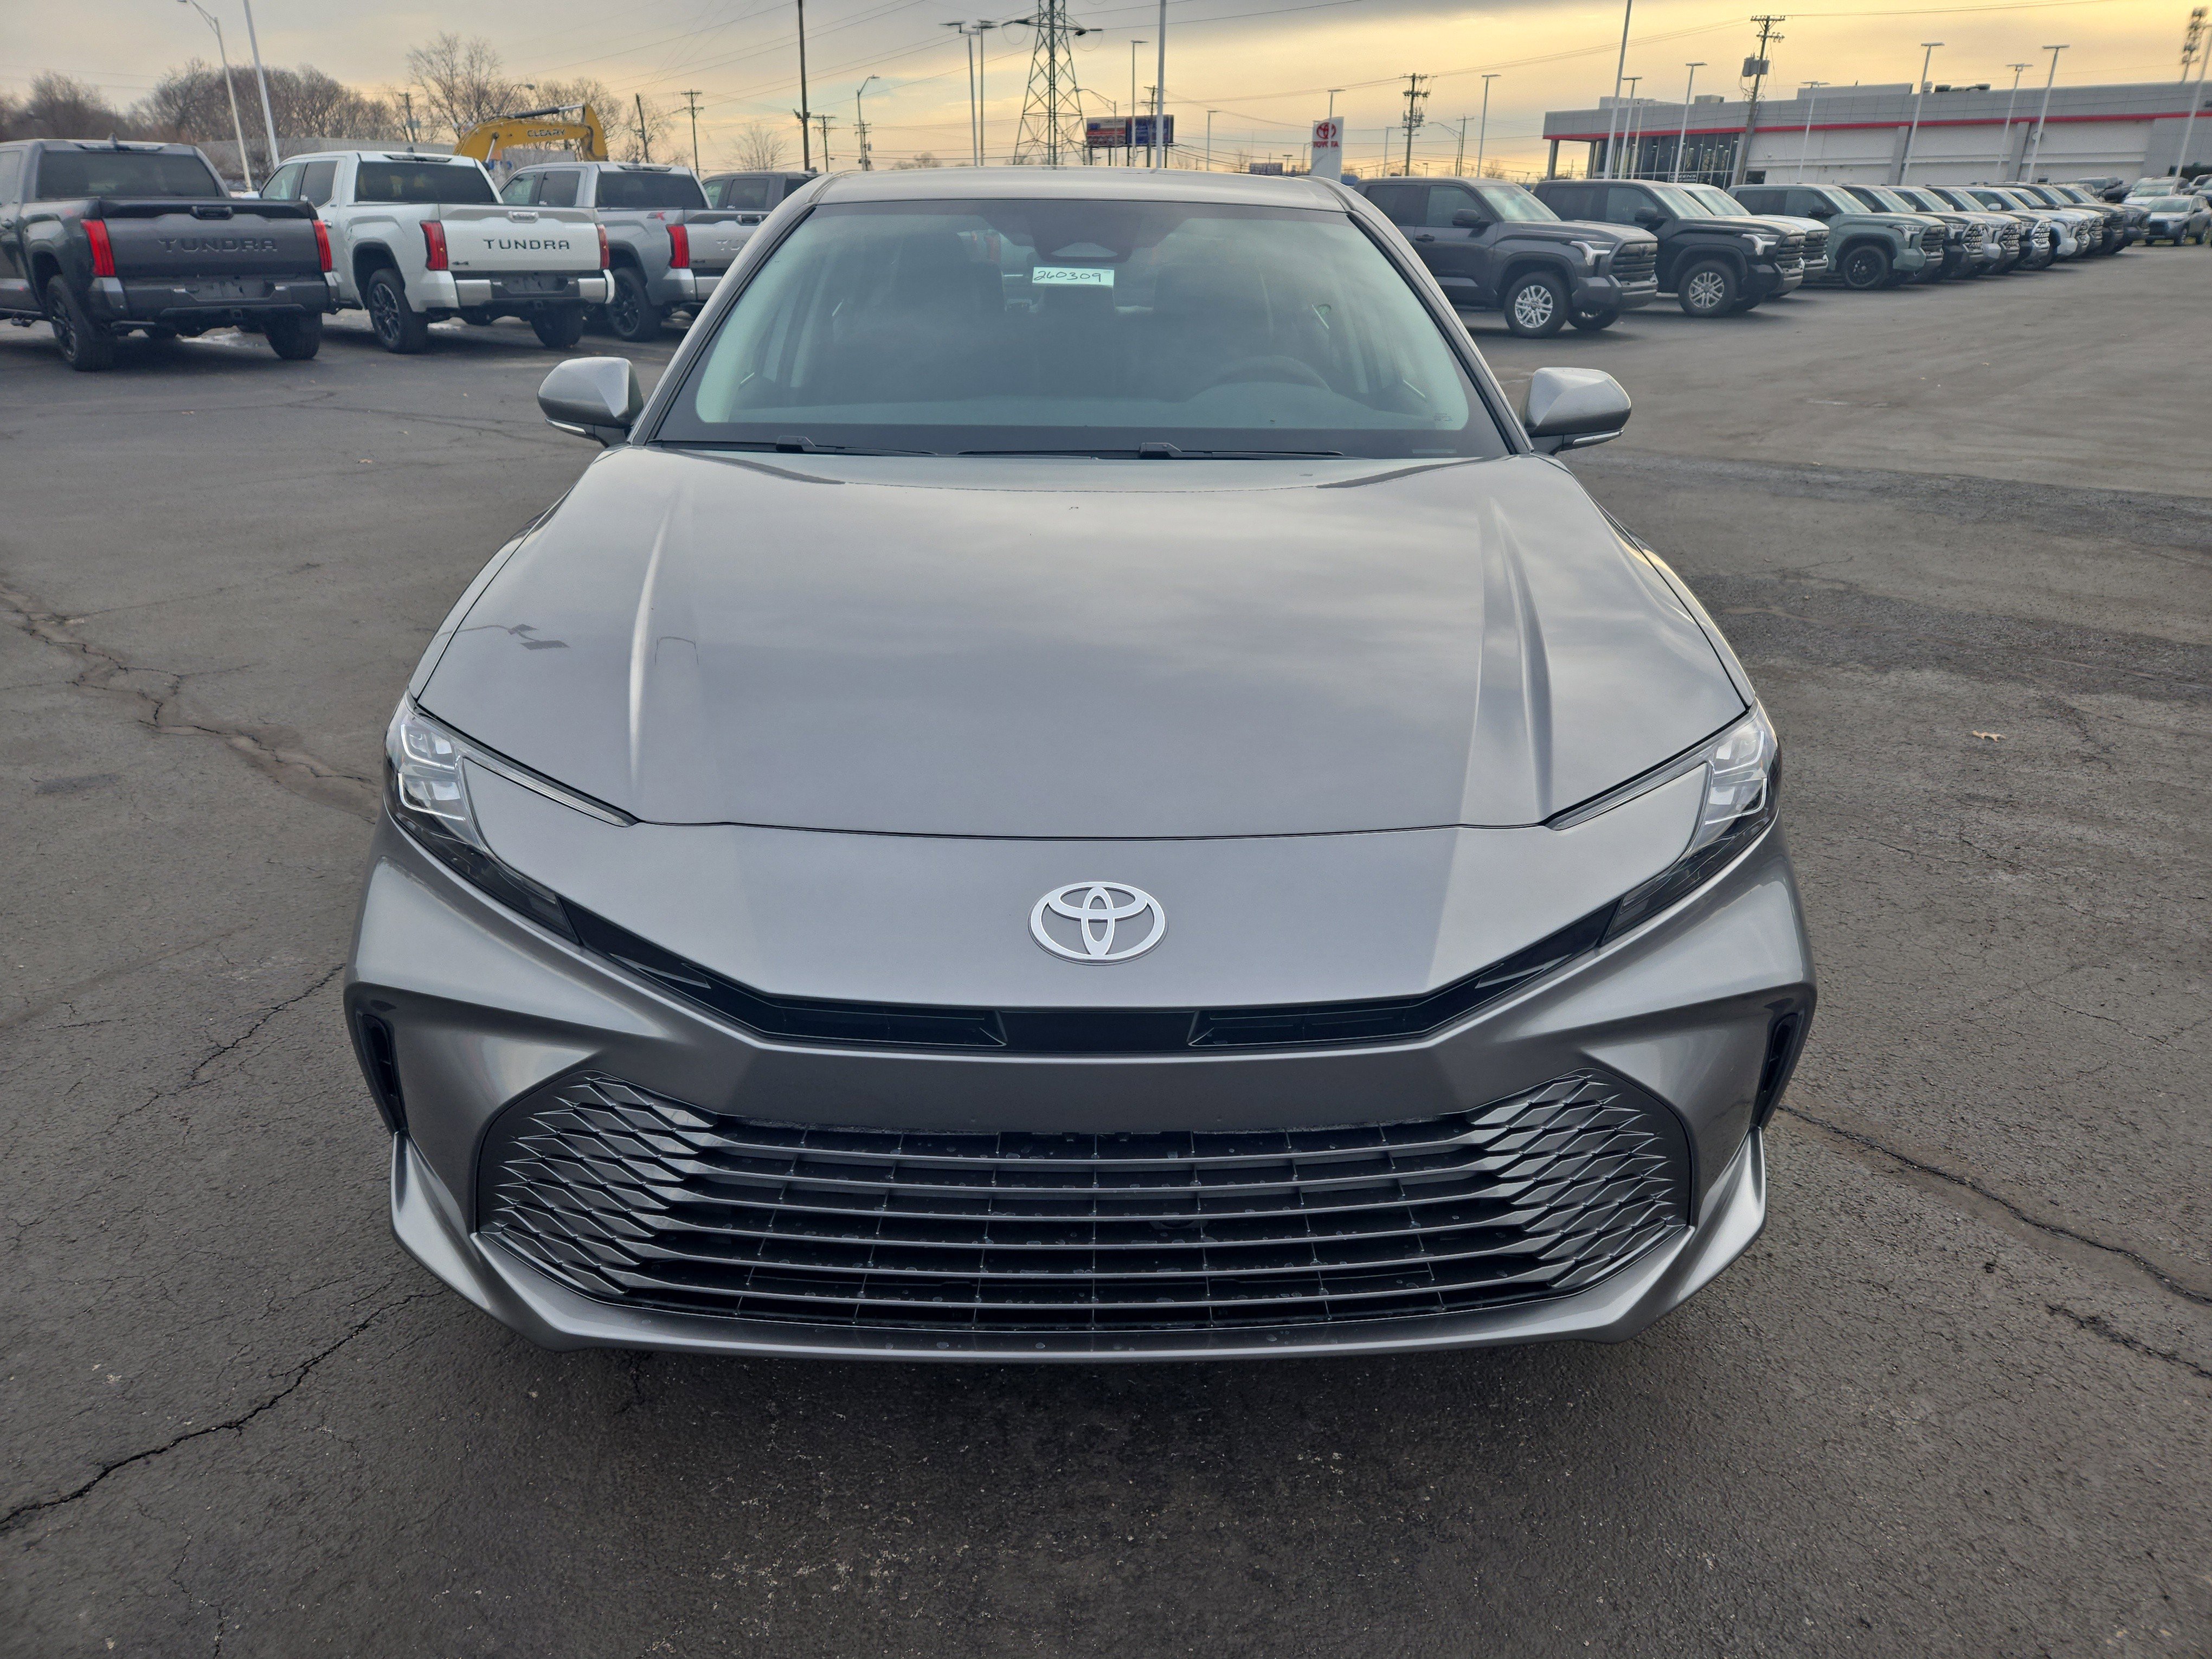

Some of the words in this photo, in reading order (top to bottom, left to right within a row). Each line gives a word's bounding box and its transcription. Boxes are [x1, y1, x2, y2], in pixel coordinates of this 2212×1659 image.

[158, 237, 278, 252] TUNDRA
[483, 239, 570, 250] TUNDRA
[1034, 271, 1101, 282] 260309
